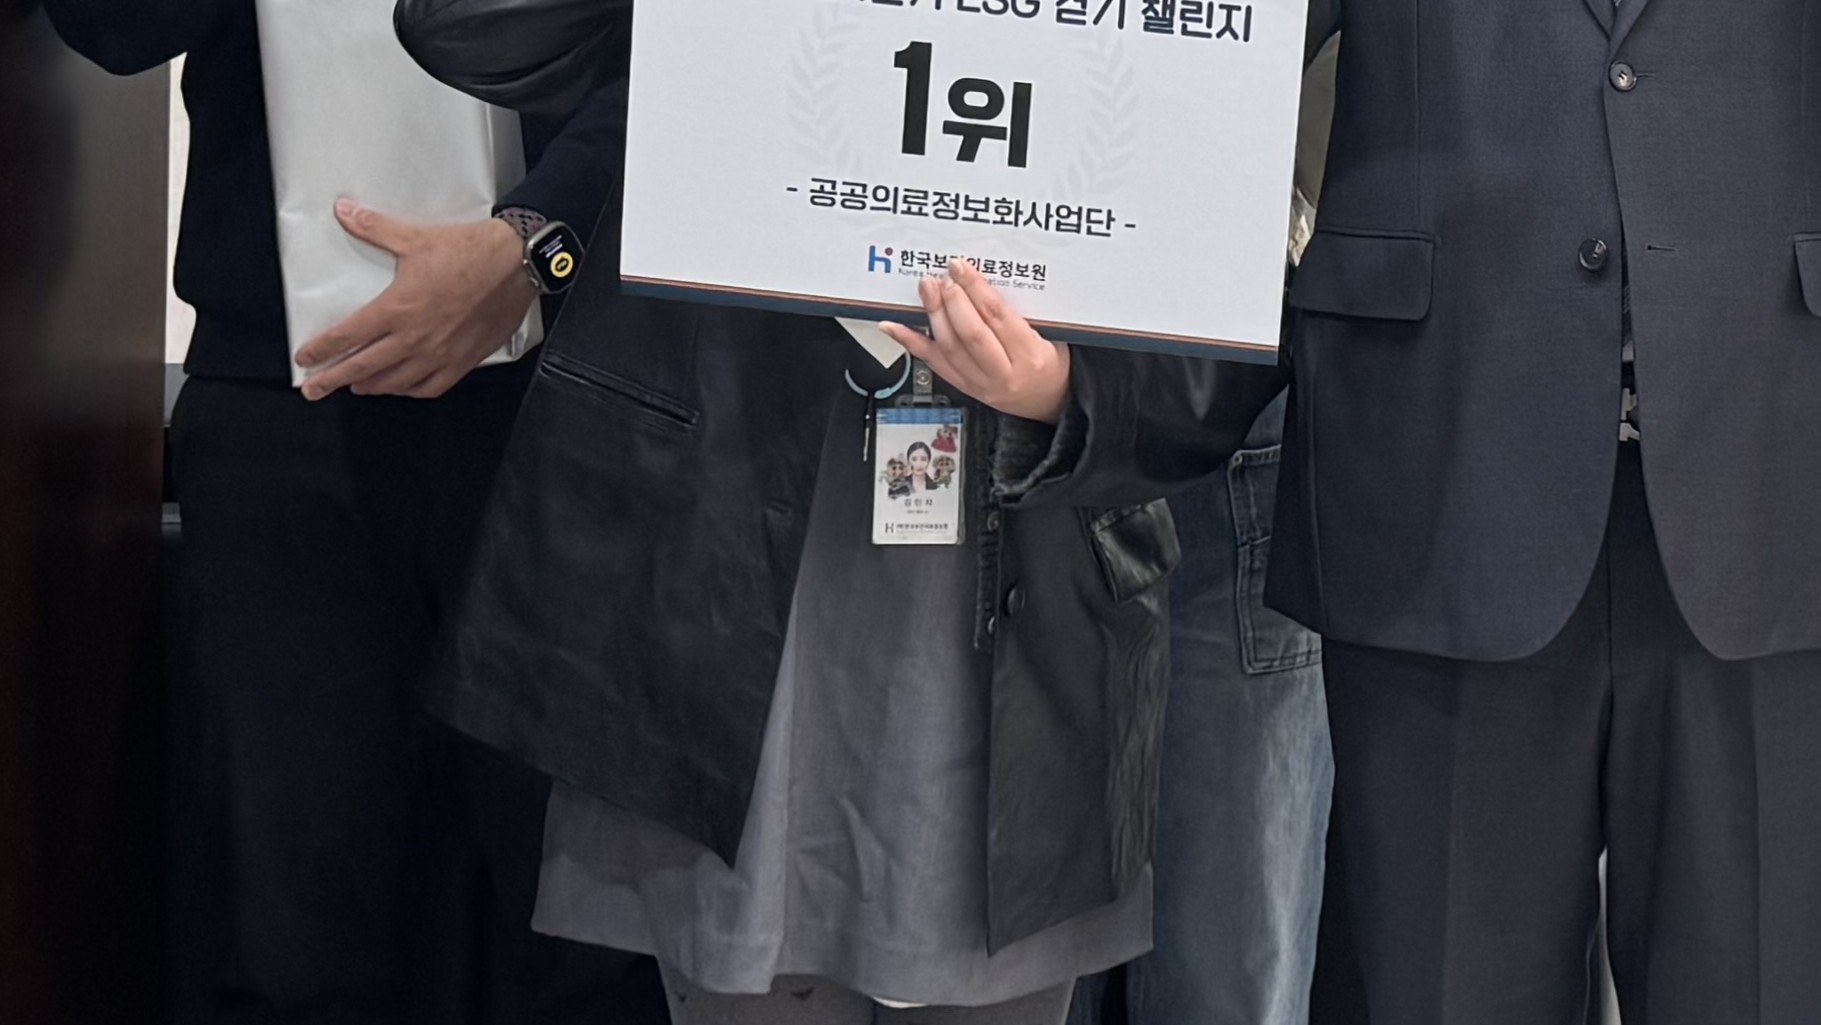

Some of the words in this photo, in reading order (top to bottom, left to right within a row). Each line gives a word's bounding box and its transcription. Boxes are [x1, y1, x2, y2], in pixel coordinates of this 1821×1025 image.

[893, 41, 1032, 169] 1위
[808, 176, 1117, 239] 공공의료정보화사업단
[900, 249, 1047, 281] 한국보의료정보원
[1012, 279, 1046, 291] Service
